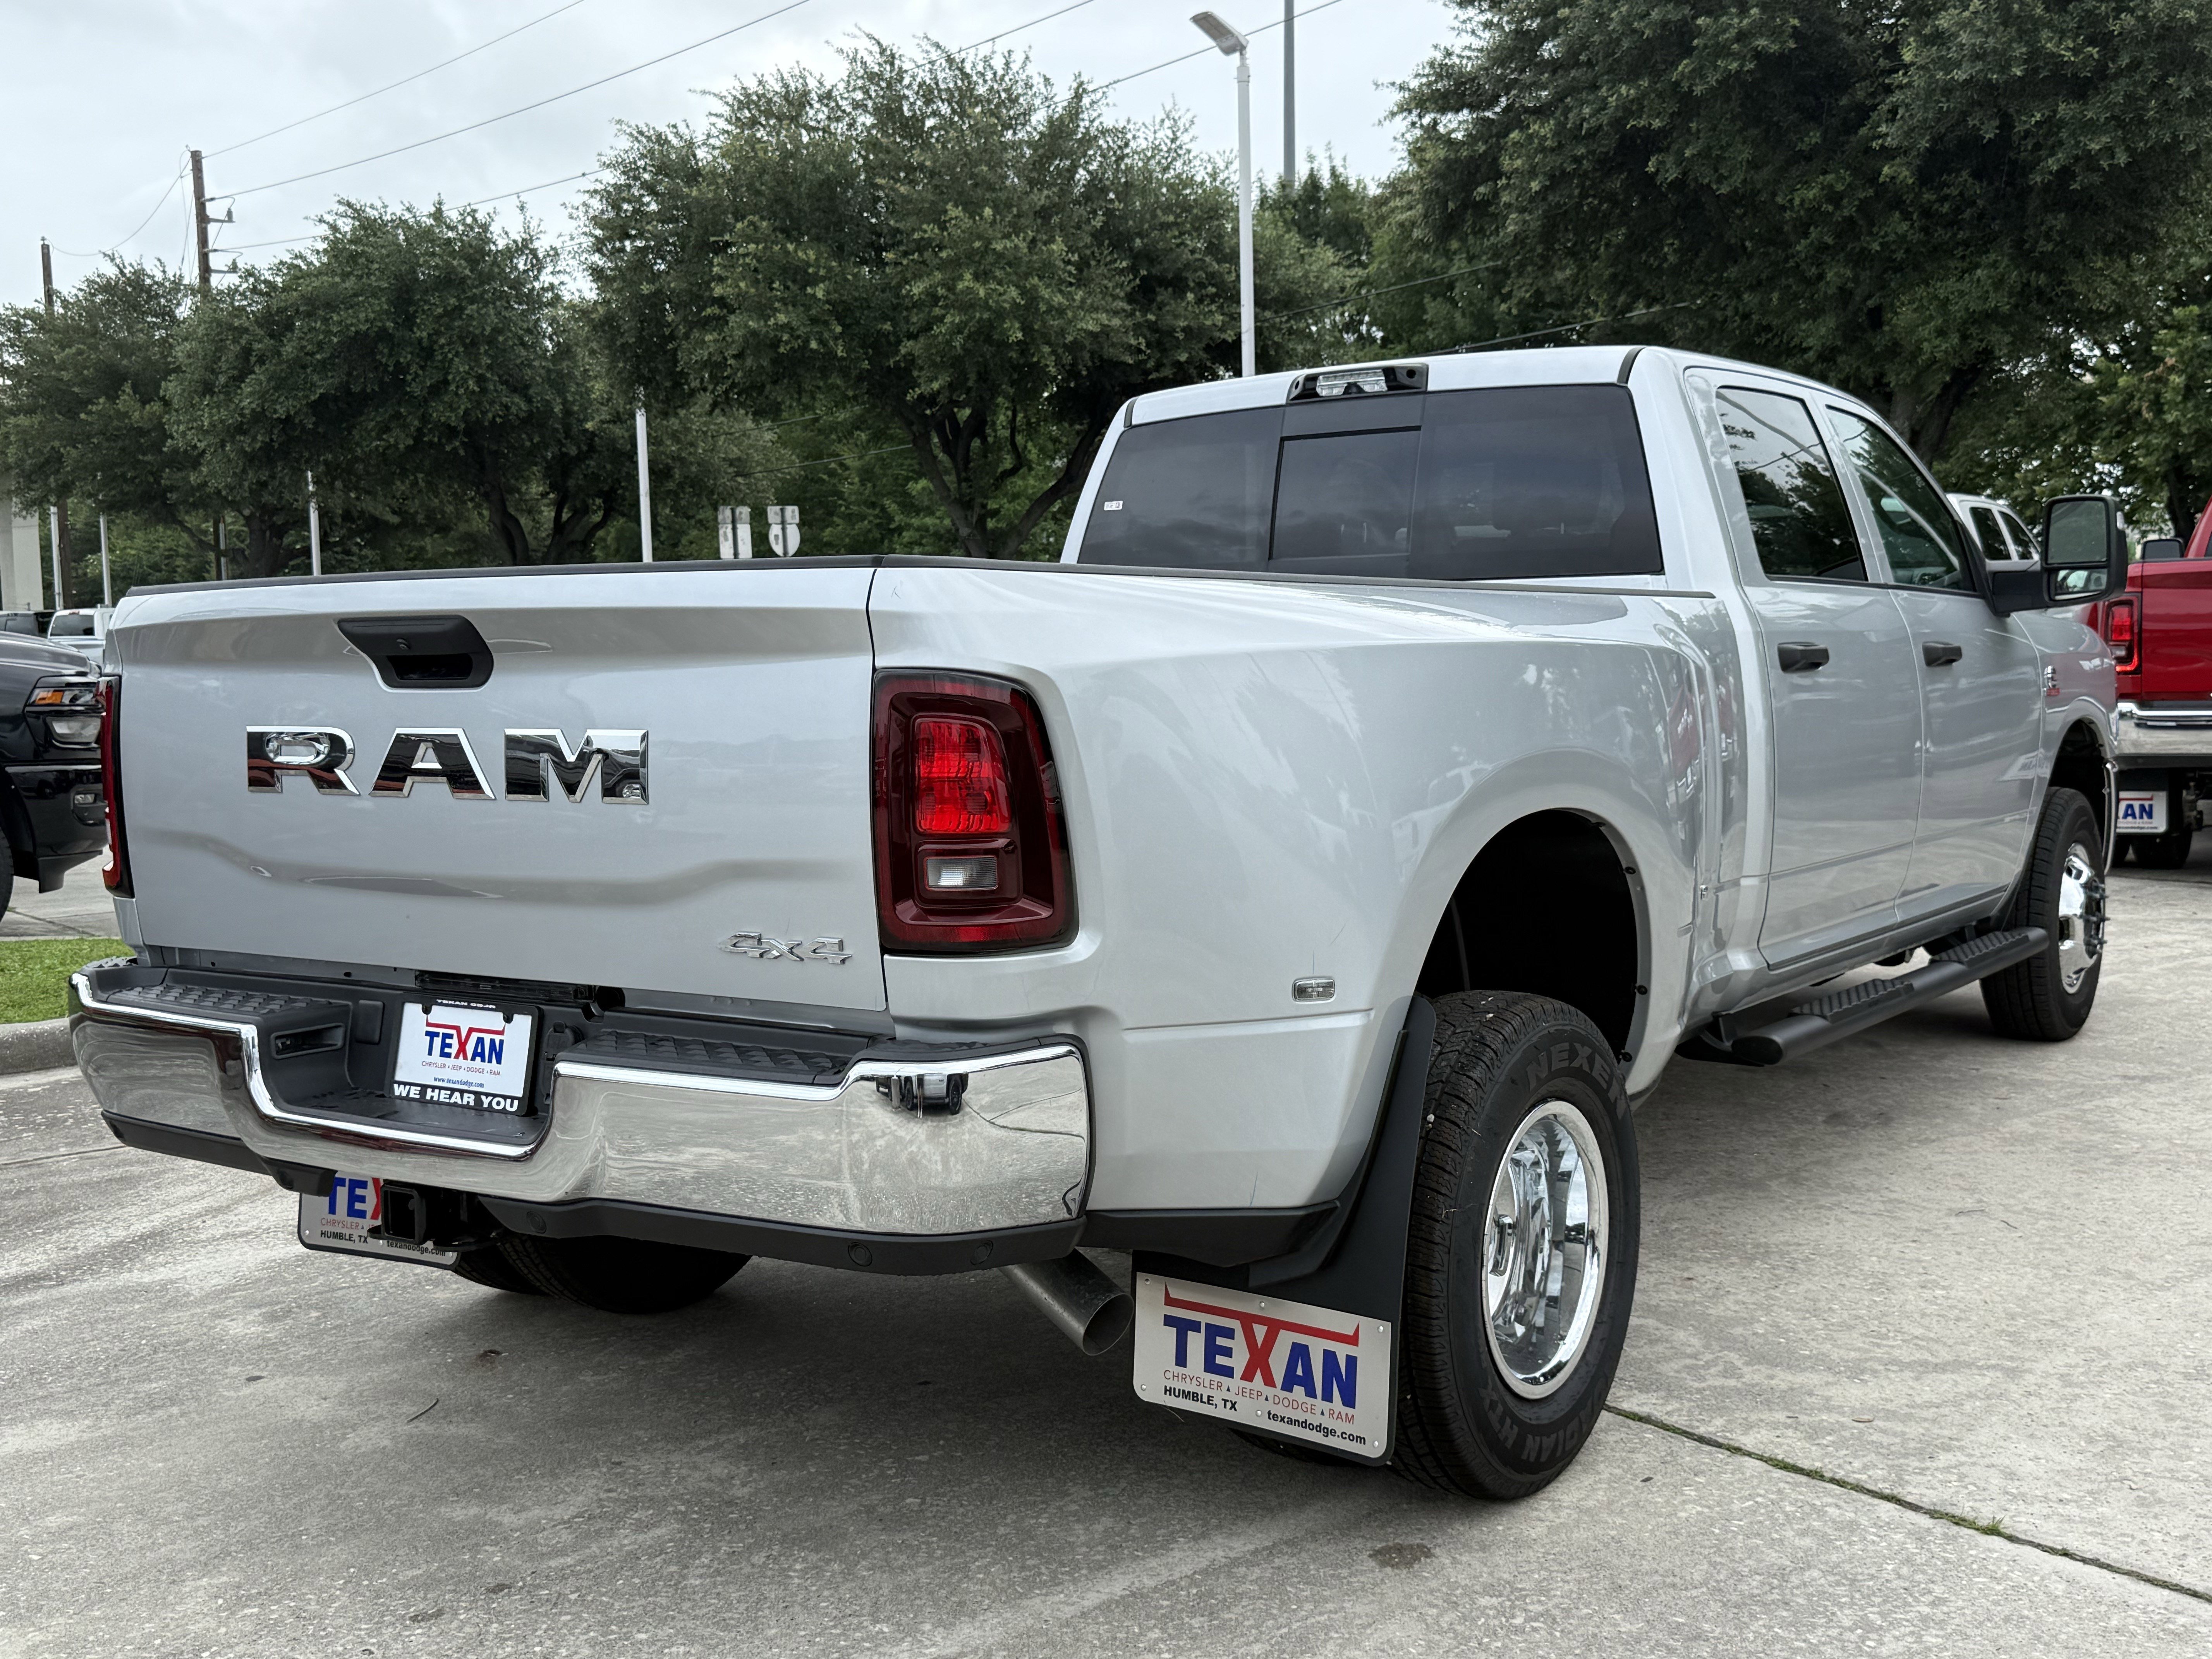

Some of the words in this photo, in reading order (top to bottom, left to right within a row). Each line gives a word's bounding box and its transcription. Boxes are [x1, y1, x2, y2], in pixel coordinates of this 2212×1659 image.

[246, 726, 649, 804] RAM
[425, 1026, 505, 1065] TEXAN
[422, 1060, 447, 1069] CHRYSLER
[467, 1066, 485, 1074] DODGE
[434, 1077, 484, 1089] www.texandodge.com
[1526, 1042, 1628, 1121] NEXEN
[393, 1084, 421, 1099] WE
[426, 1088, 475, 1106] HEAR
[480, 1095, 519, 1112] YOU
[320, 1230, 356, 1243] HUMBLE,
[321, 1217, 360, 1230] CHRYSLER
[1163, 1312, 1358, 1410] TEXAN
[1164, 1369, 1223, 1393] CHRYSLER
[1235, 1386, 1263, 1401] JEEP
[1273, 1394, 1317, 1415] DODGE
[1328, 1409, 1355, 1425] RAM
[1164, 1385, 1218, 1410] HUMBLE,
[1221, 1398, 1238, 1412] TX
[1267, 1410, 1367, 1446] texandodge.com
